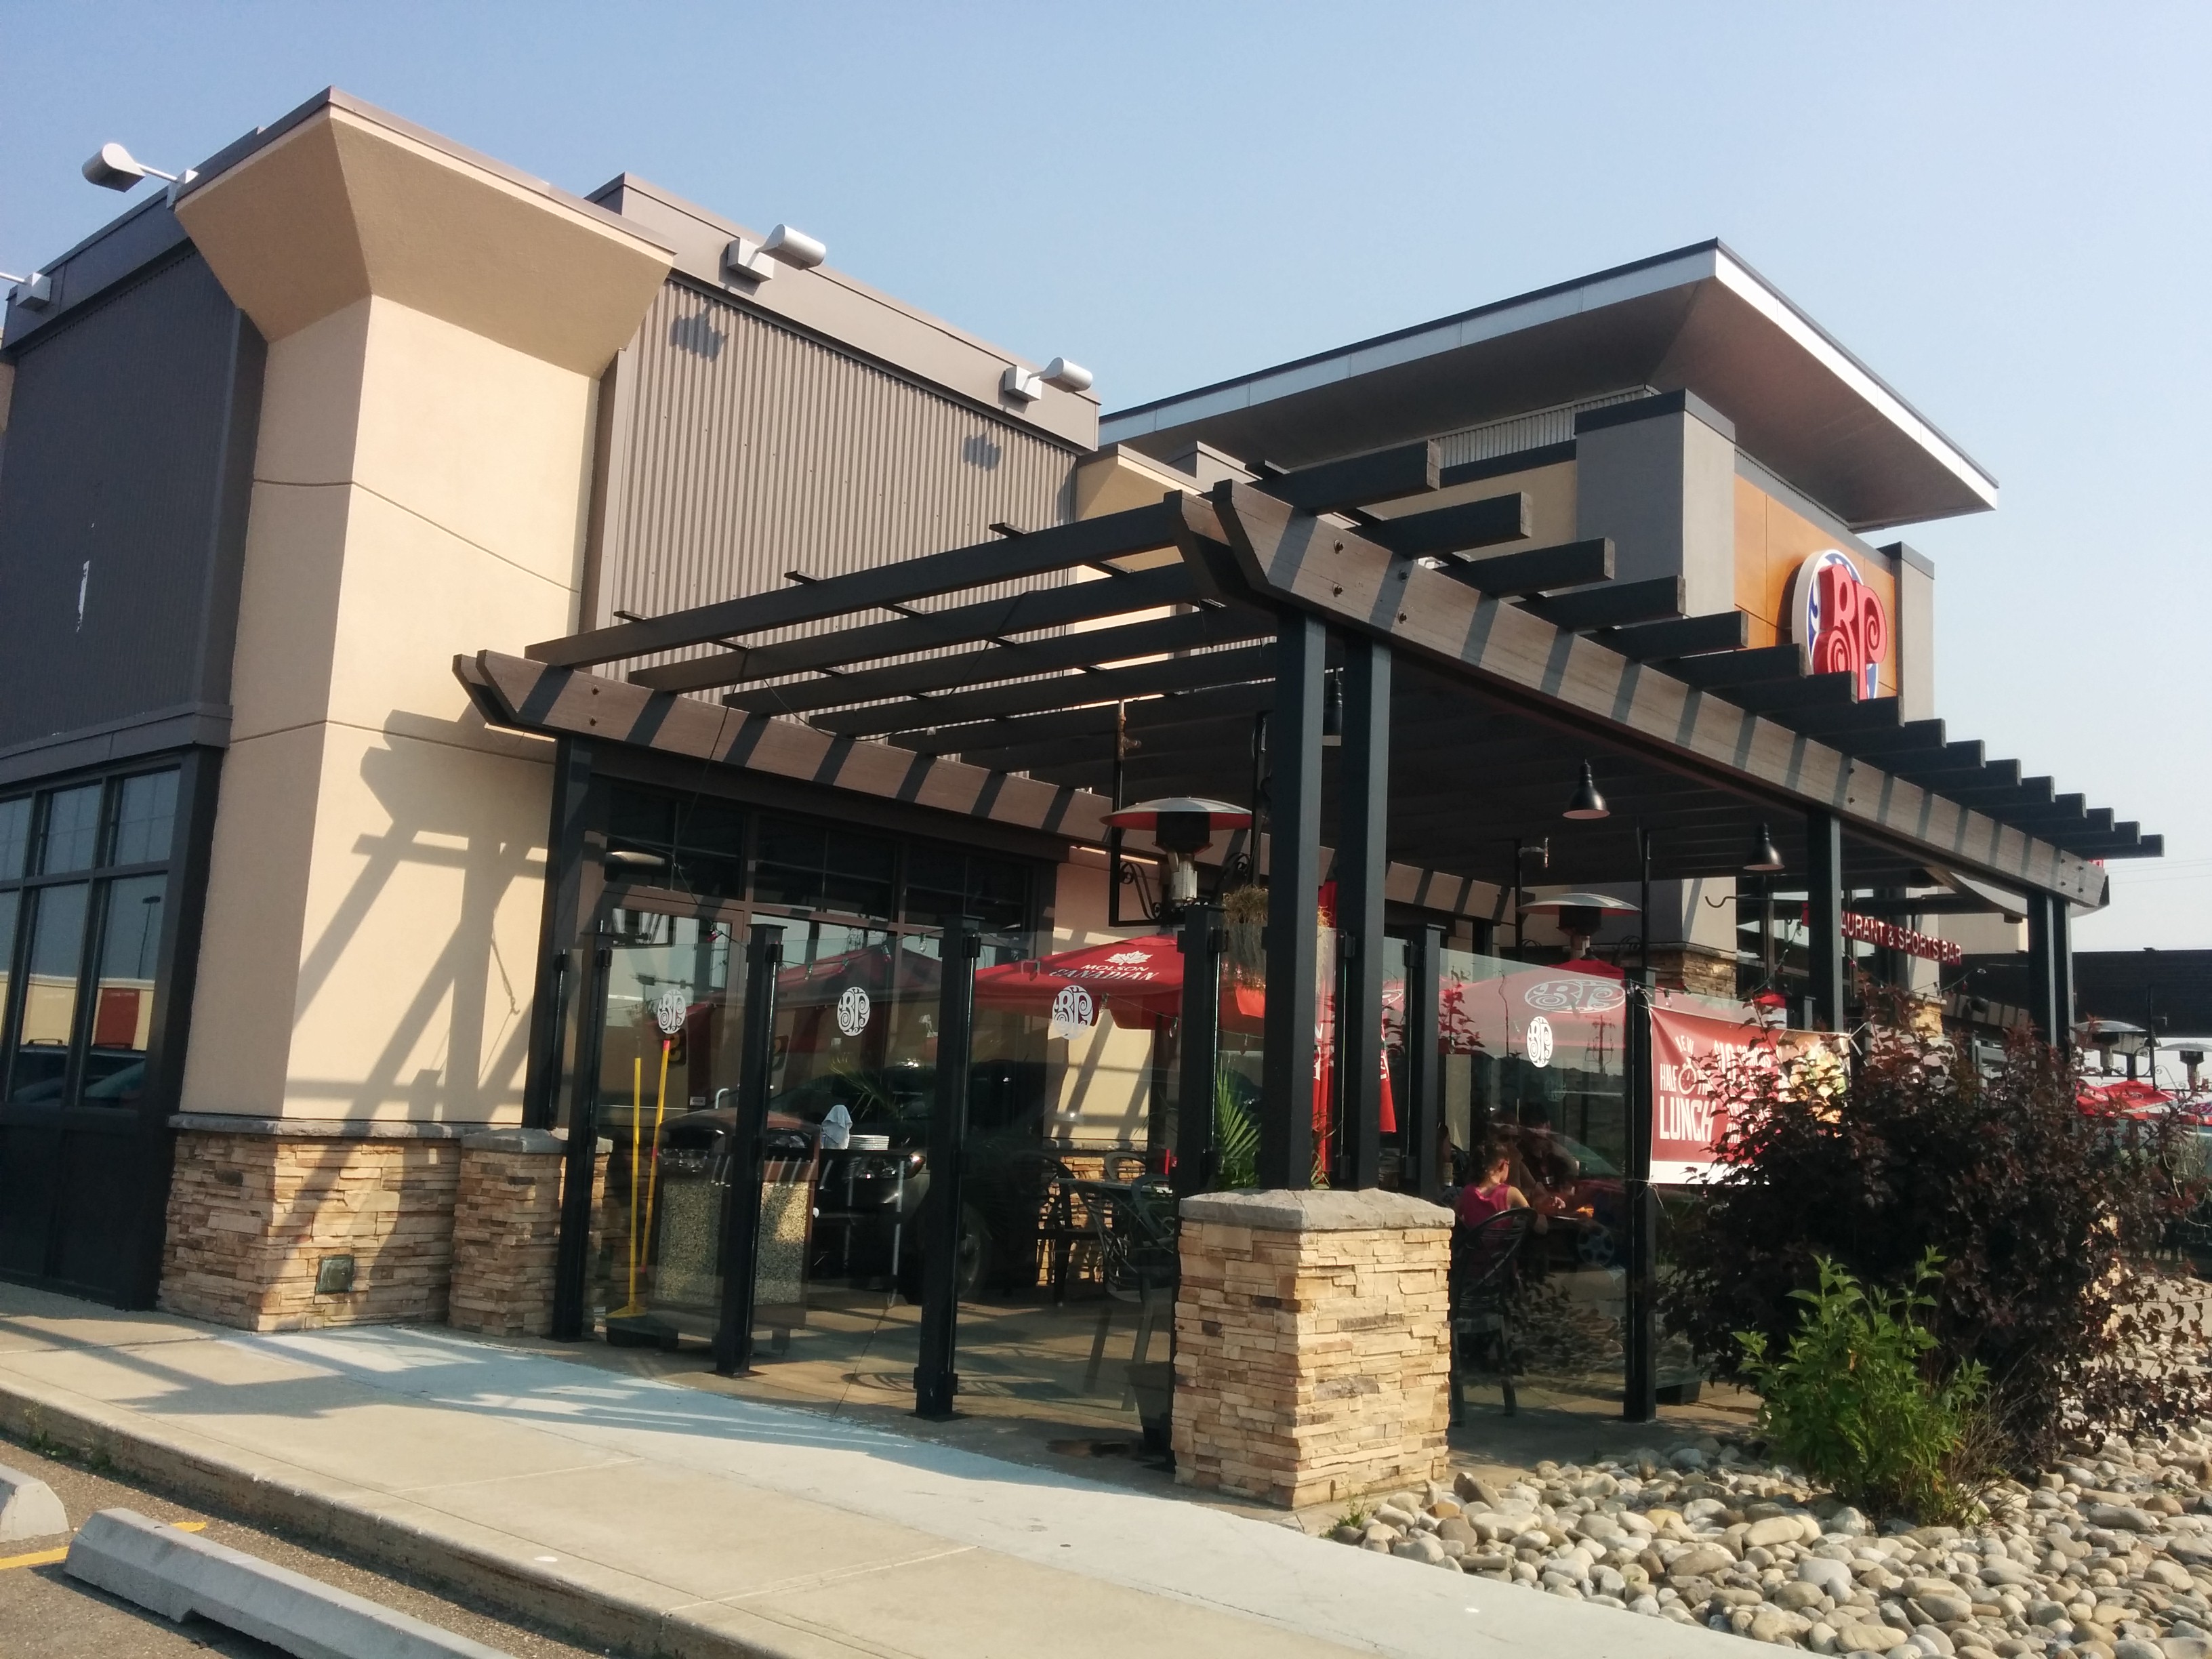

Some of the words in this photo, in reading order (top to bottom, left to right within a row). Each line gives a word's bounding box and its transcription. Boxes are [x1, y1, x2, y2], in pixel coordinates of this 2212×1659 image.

[1841, 910, 1885, 943] AURANT
[1888, 924, 1894, 947] &
[1898, 926, 1939, 960] SPORTS
[1941, 939, 1962, 963] BAR
[1049, 968, 1160, 981] CANADIAN
[658, 991, 686, 1032] BP
[838, 989, 870, 1033] BP
[1675, 1035, 1694, 1054] NEW
[1660, 1063, 1679, 1092] HALF
[1660, 1096, 1717, 1143] LUNCH
